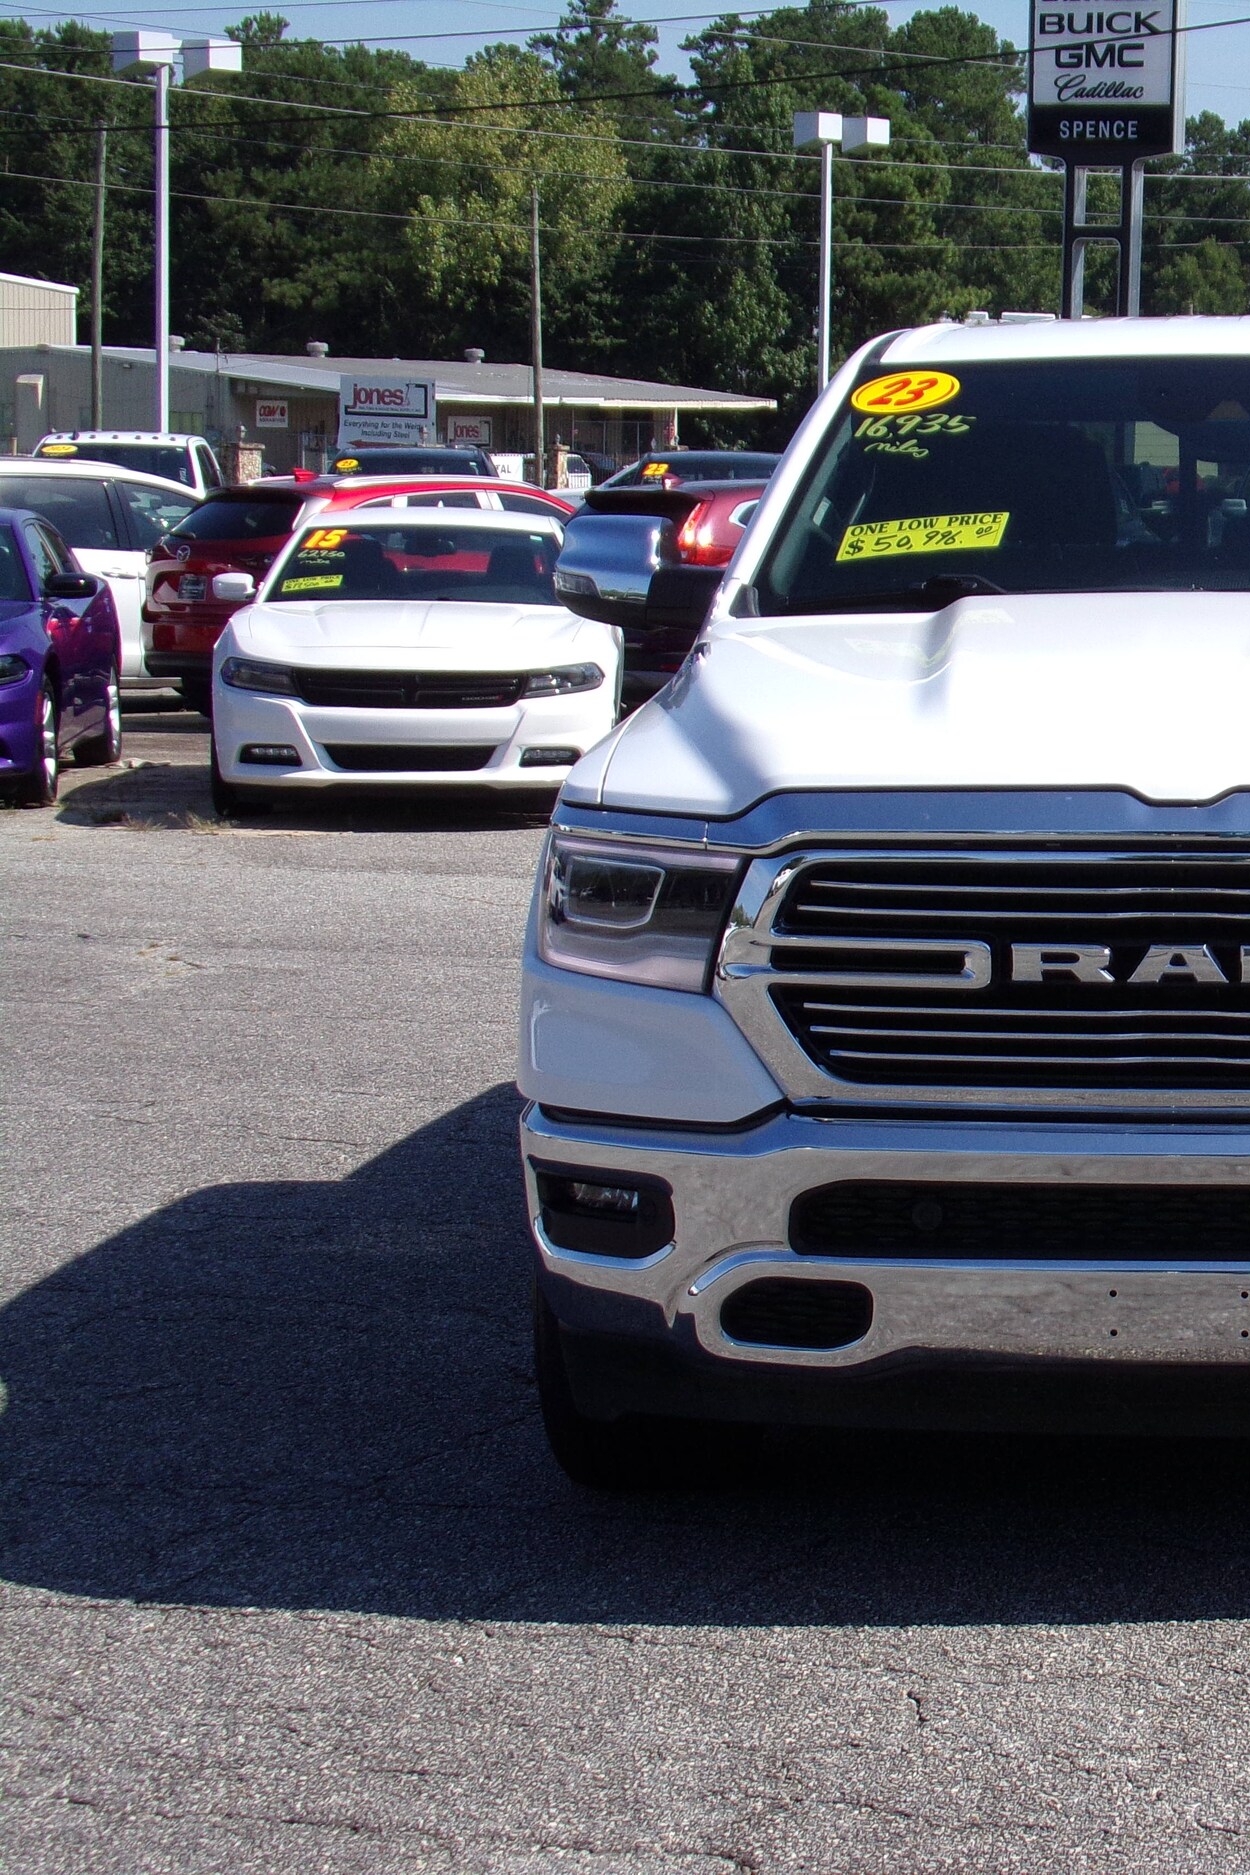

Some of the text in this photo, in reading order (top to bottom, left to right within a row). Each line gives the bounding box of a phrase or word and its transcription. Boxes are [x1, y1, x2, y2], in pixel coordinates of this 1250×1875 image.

[1039, 11, 1162, 35] BUICK
[1055, 43, 1145, 69] GMC
[1053, 73, 1144, 102] Cadillac
[1059, 120, 1139, 139] SPENCE
[352, 383, 404, 409] jones
[866, 377, 939, 406] 23
[343, 420, 380, 430] Everything
[392, 421, 403, 429] the
[854, 413, 977, 438] 16,935
[643, 462, 670, 475] 23
[850, 512, 1004, 538] ONE LOW PRICE
[303, 529, 348, 549] 15
